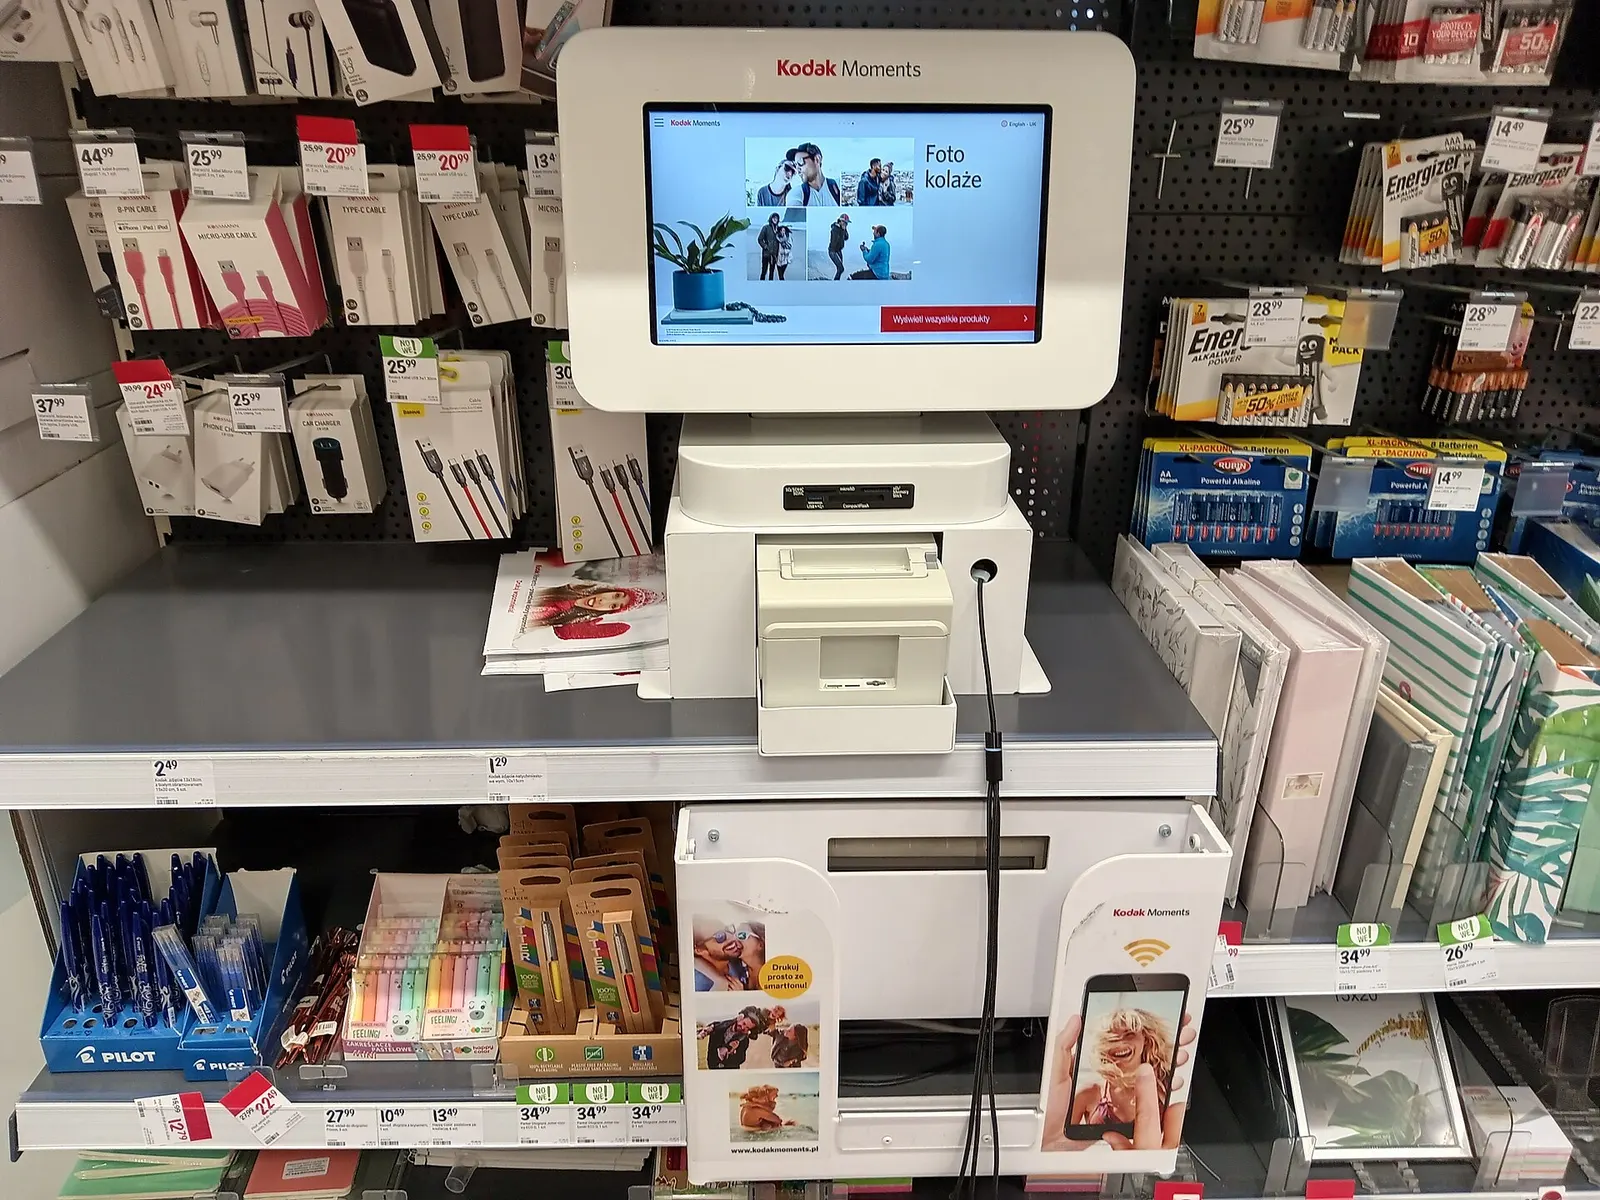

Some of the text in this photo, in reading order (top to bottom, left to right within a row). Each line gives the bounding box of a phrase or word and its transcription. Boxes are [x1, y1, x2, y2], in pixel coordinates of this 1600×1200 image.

[1440, 22, 1472, 30] PROTECTS
[1432, 30, 1450, 38] YOUR
[1403, 33, 1418, 46] 10
[777, 59, 922, 77] Kodak Moments
[303, 144, 323, 152] 25,99
[416, 152, 436, 161] 25,99
[926, 144, 965, 164] Foto
[925, 170, 982, 189] kolaże
[1386, 154, 1462, 197] Energizer
[1508, 166, 1572, 188] Energizer
[118, 206, 136, 214] 8-PIN
[442, 209, 480, 222] TYPE-C CABLE
[198, 232, 236, 240] MICRO-USB
[1198, 304, 1204, 314] 7
[893, 314, 990, 325] Wyświetl wszystkie produkty
[1331, 346, 1360, 354] PACK
[1192, 348, 1236, 362] ALKALINE
[1208, 355, 1242, 366] POWER
[1246, 396, 1275, 412] 50%
[202, 422, 224, 432] PHONE
[1438, 441, 1478, 450] Batterien
[1371, 448, 1428, 458] XL-PACKUNG
[1218, 462, 1247, 471] RUBIN
[1200, 476, 1261, 486] Powerful Alkaline
[1113, 908, 1190, 917] Kodak Moments
[1356, 926, 1367, 935] NO
[1458, 922, 1468, 932] NO
[772, 964, 799, 972] Drukuj
[767, 973, 794, 982] prosto
[764, 982, 808, 990] smartfonu!
[430, 1016, 458, 1024] FEELING!
[352, 1029, 380, 1038] FEELING!
[102, 1052, 156, 1063] PILOT
[210, 1062, 245, 1070] PILOT
[536, 1086, 546, 1094] NO
[592, 1086, 603, 1094] NO
[648, 1086, 658, 1094] NO
[730, 1146, 819, 1154] www.kodakmoments.pl
